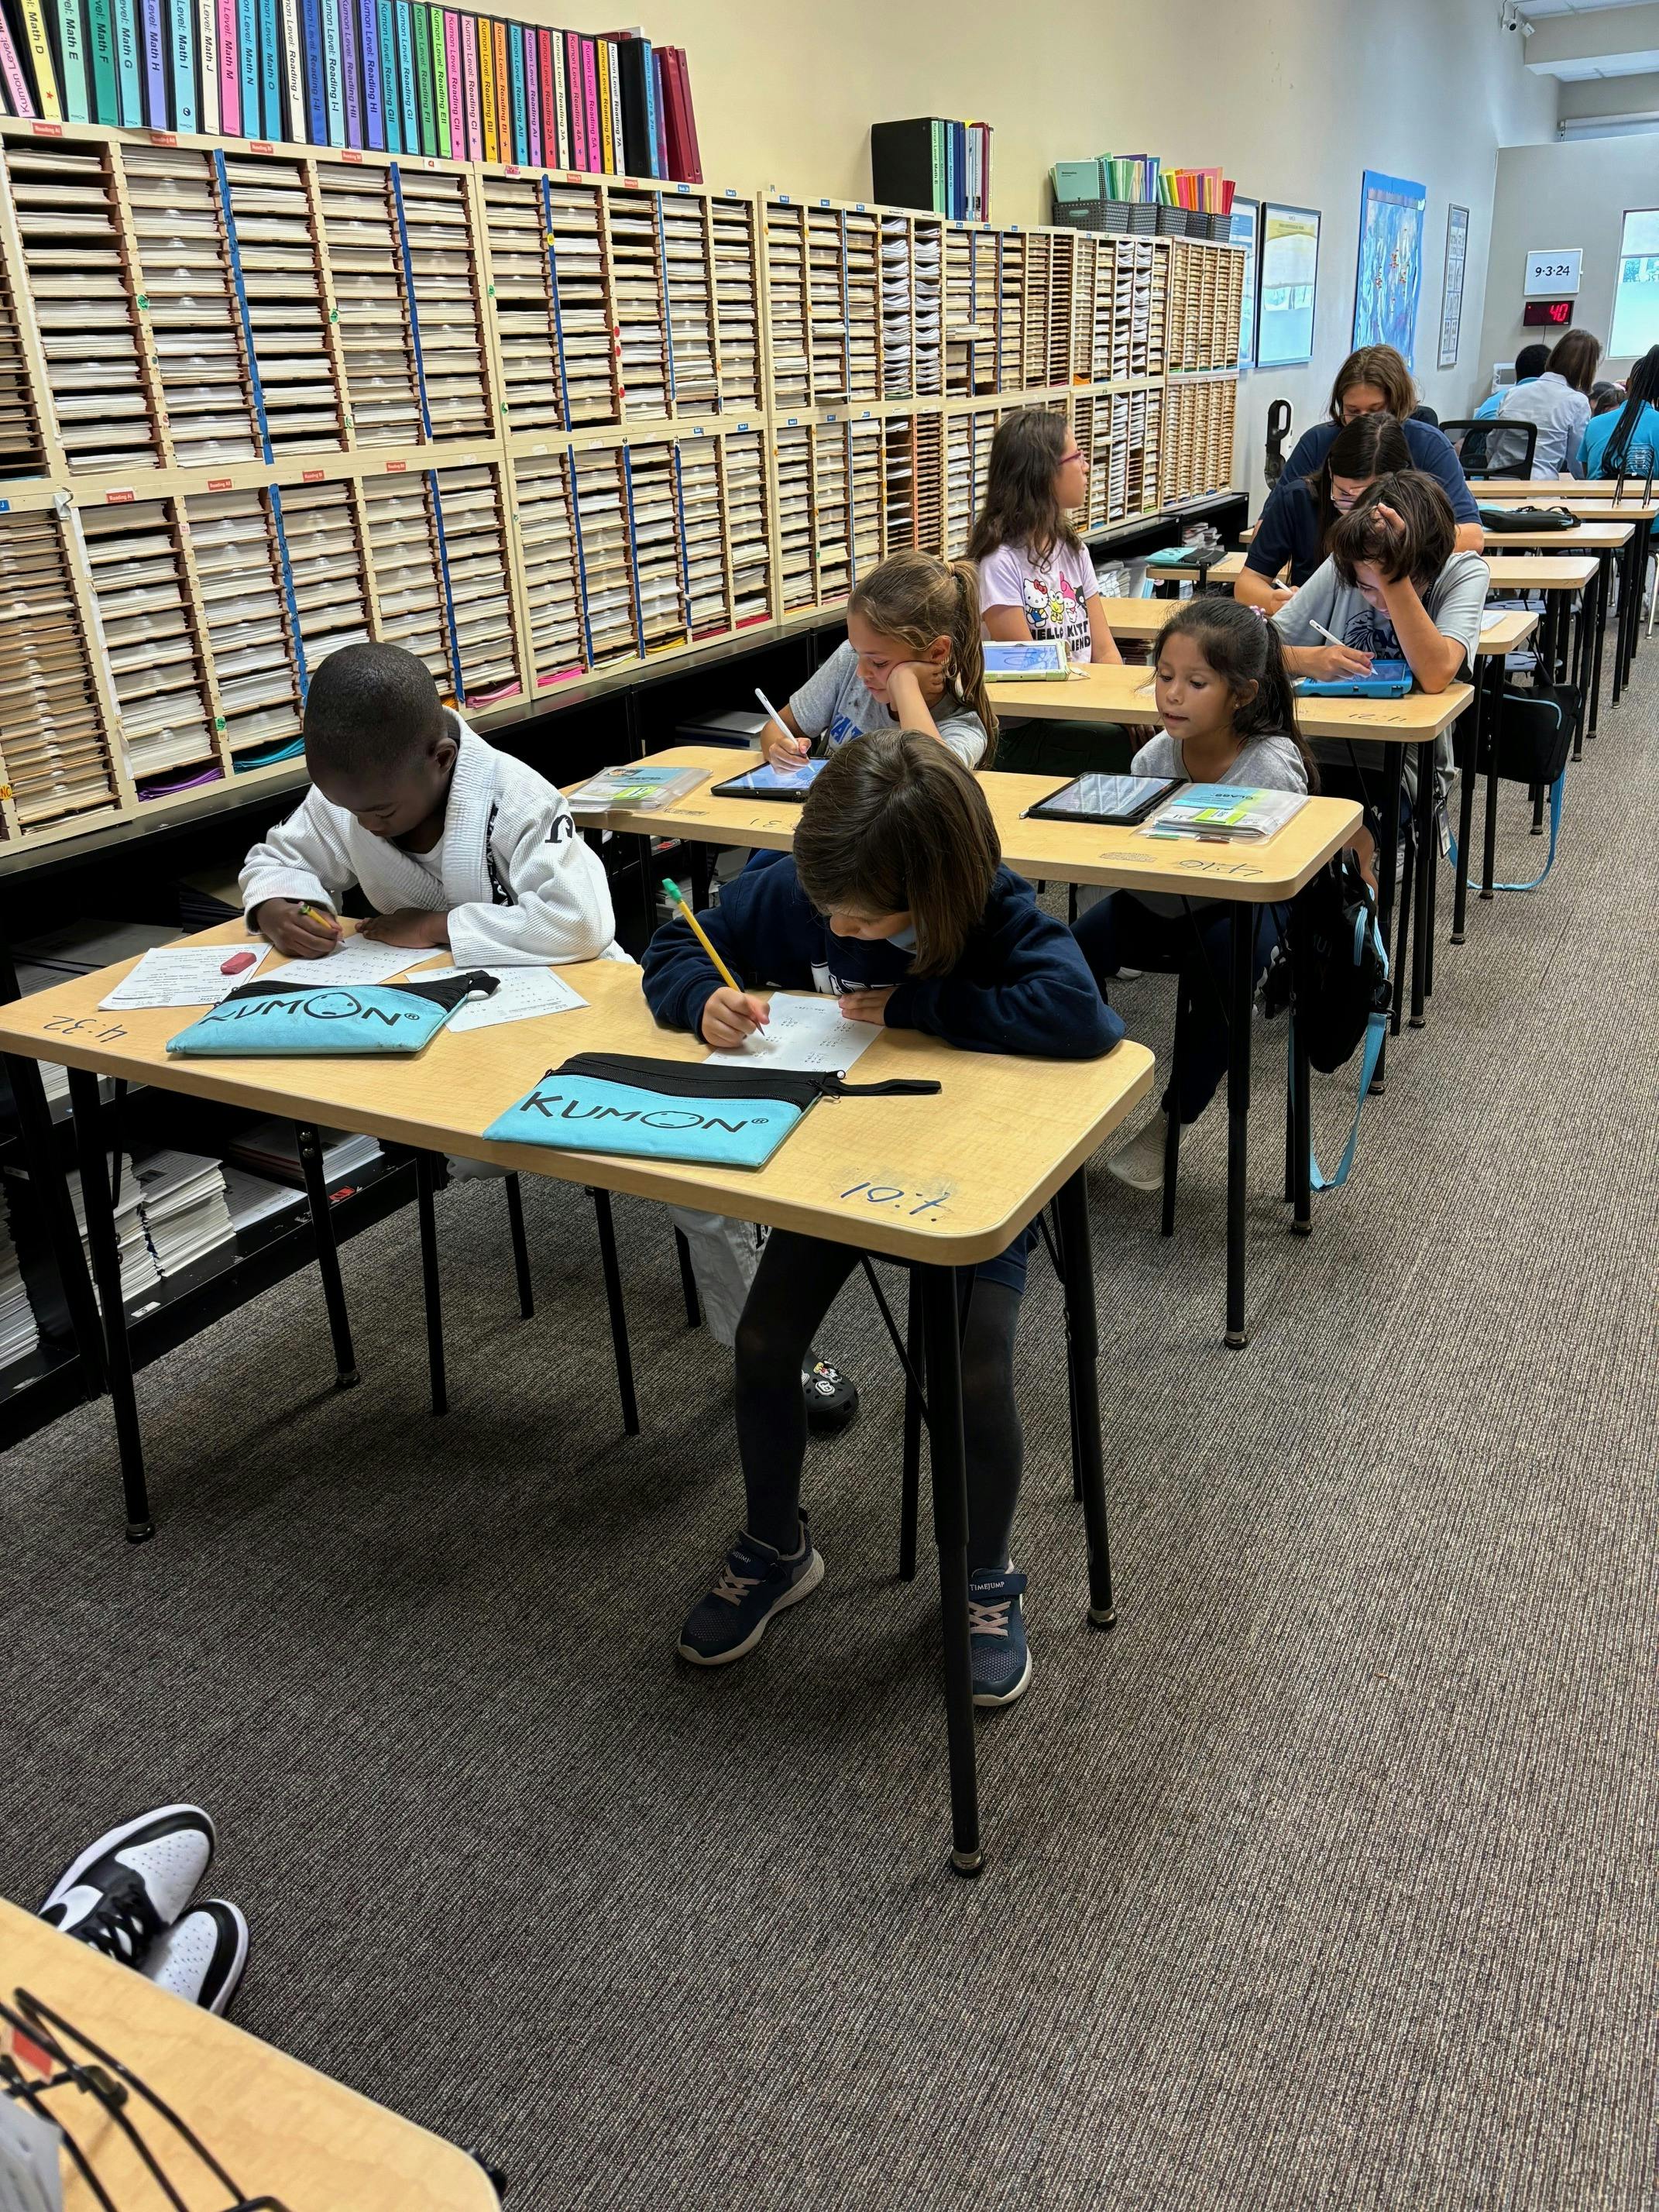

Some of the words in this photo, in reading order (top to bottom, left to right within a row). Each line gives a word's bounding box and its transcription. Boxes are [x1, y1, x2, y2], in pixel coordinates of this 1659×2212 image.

[177, 0, 187, 32] Level:
[203, 4, 211, 33] Level:
[224, 7, 232, 38] Level:
[29, 12, 41, 40] Math
[36, 46, 44, 54] D
[66, 19, 77, 46] Math
[97, 23, 108, 51] Math
[122, 28, 132, 55] Math
[150, 31, 160, 59] Math
[287, 20, 296, 47] Level:
[327, 29, 335, 55] Level:
[178, 35, 188, 61] Math
[204, 36, 213, 62] Math
[225, 40, 233, 67] Math
[345, 33, 353, 60] Level:
[245, 48, 254, 73] Math
[266, 53, 275, 78] Math
[289, 50, 297, 91] Reading
[366, 31, 374, 57] Level:
[370, 102, 378, 113] HI
[226, 70, 234, 80] M
[268, 82, 275, 91] O
[311, 54, 319, 95] Reading
[329, 58, 338, 99] Reading
[347, 62, 356, 102] Reading
[385, 67, 393, 108] Reading
[401, 40, 410, 64] Level:
[407, 108, 414, 120] GI
[13, 74, 29, 112] Kumon
[472, 121, 478, 130] CI
[533, 129, 538, 138] AI
[548, 129, 553, 140] 2A
[576, 130, 582, 141] 4A
[592, 136, 596, 148] 5A
[617, 136, 622, 147] 7A
[1549, 303, 1569, 322] 40
[1067, 620, 1088, 638] KITT
[1348, 713, 1407, 723] 4:21
[1179, 860, 1263, 877] 4:10
[43, 1015, 129, 1043] 4:32
[969, 1581, 1005, 1592] TIMEJUMP
